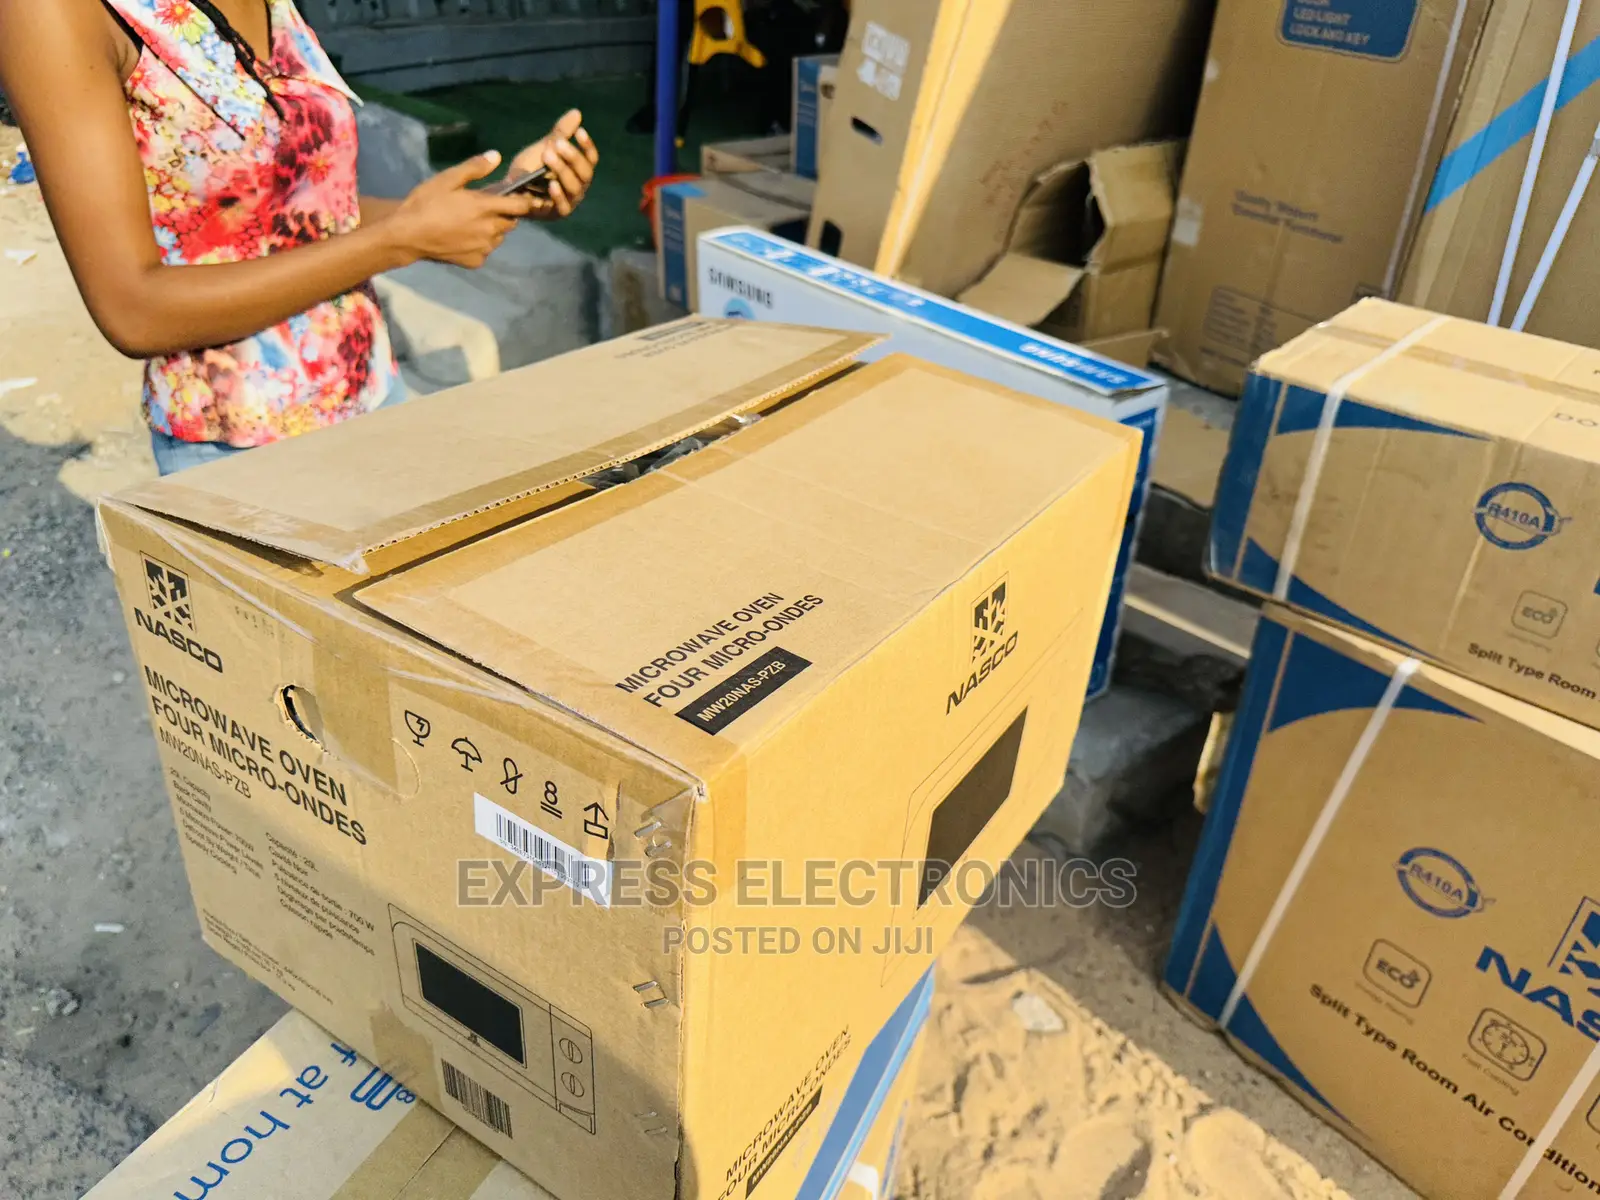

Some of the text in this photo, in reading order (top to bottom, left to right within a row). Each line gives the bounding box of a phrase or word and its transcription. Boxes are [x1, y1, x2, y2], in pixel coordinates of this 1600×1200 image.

[708, 266, 774, 309] SAMSUNG
[1487, 501, 1541, 530] R410A
[133, 607, 224, 674] NASCO
[614, 592, 785, 694] MICROWAVE OVEN
[1521, 606, 1555, 625] ECO
[643, 594, 824, 709] FOUR MICRO-ONDES
[945, 630, 1019, 716] NASCO
[1467, 641, 1504, 666] Split
[1508, 656, 1545, 680] Type
[1547, 672, 1597, 700] Room
[696, 659, 787, 723] MW20NAS-PZB
[144, 664, 349, 807] MICROWAVE OVEN
[151, 695, 367, 846] FOUR MICRO-ONDES
[158, 725, 252, 799] MW20NAS-PZB
[1408, 860, 1464, 902] R410A
[1375, 956, 1418, 991] ECO
[1308, 982, 1352, 1019] Split
[1353, 1010, 1398, 1053] Type
[1401, 1046, 1460, 1096] Room
[1461, 1091, 1495, 1118] Air
[279, 1064, 329, 1109] at
[725, 1023, 850, 1183] MICROWAVE OVEN
[761, 1034, 852, 1154] MICRO-ONDES
